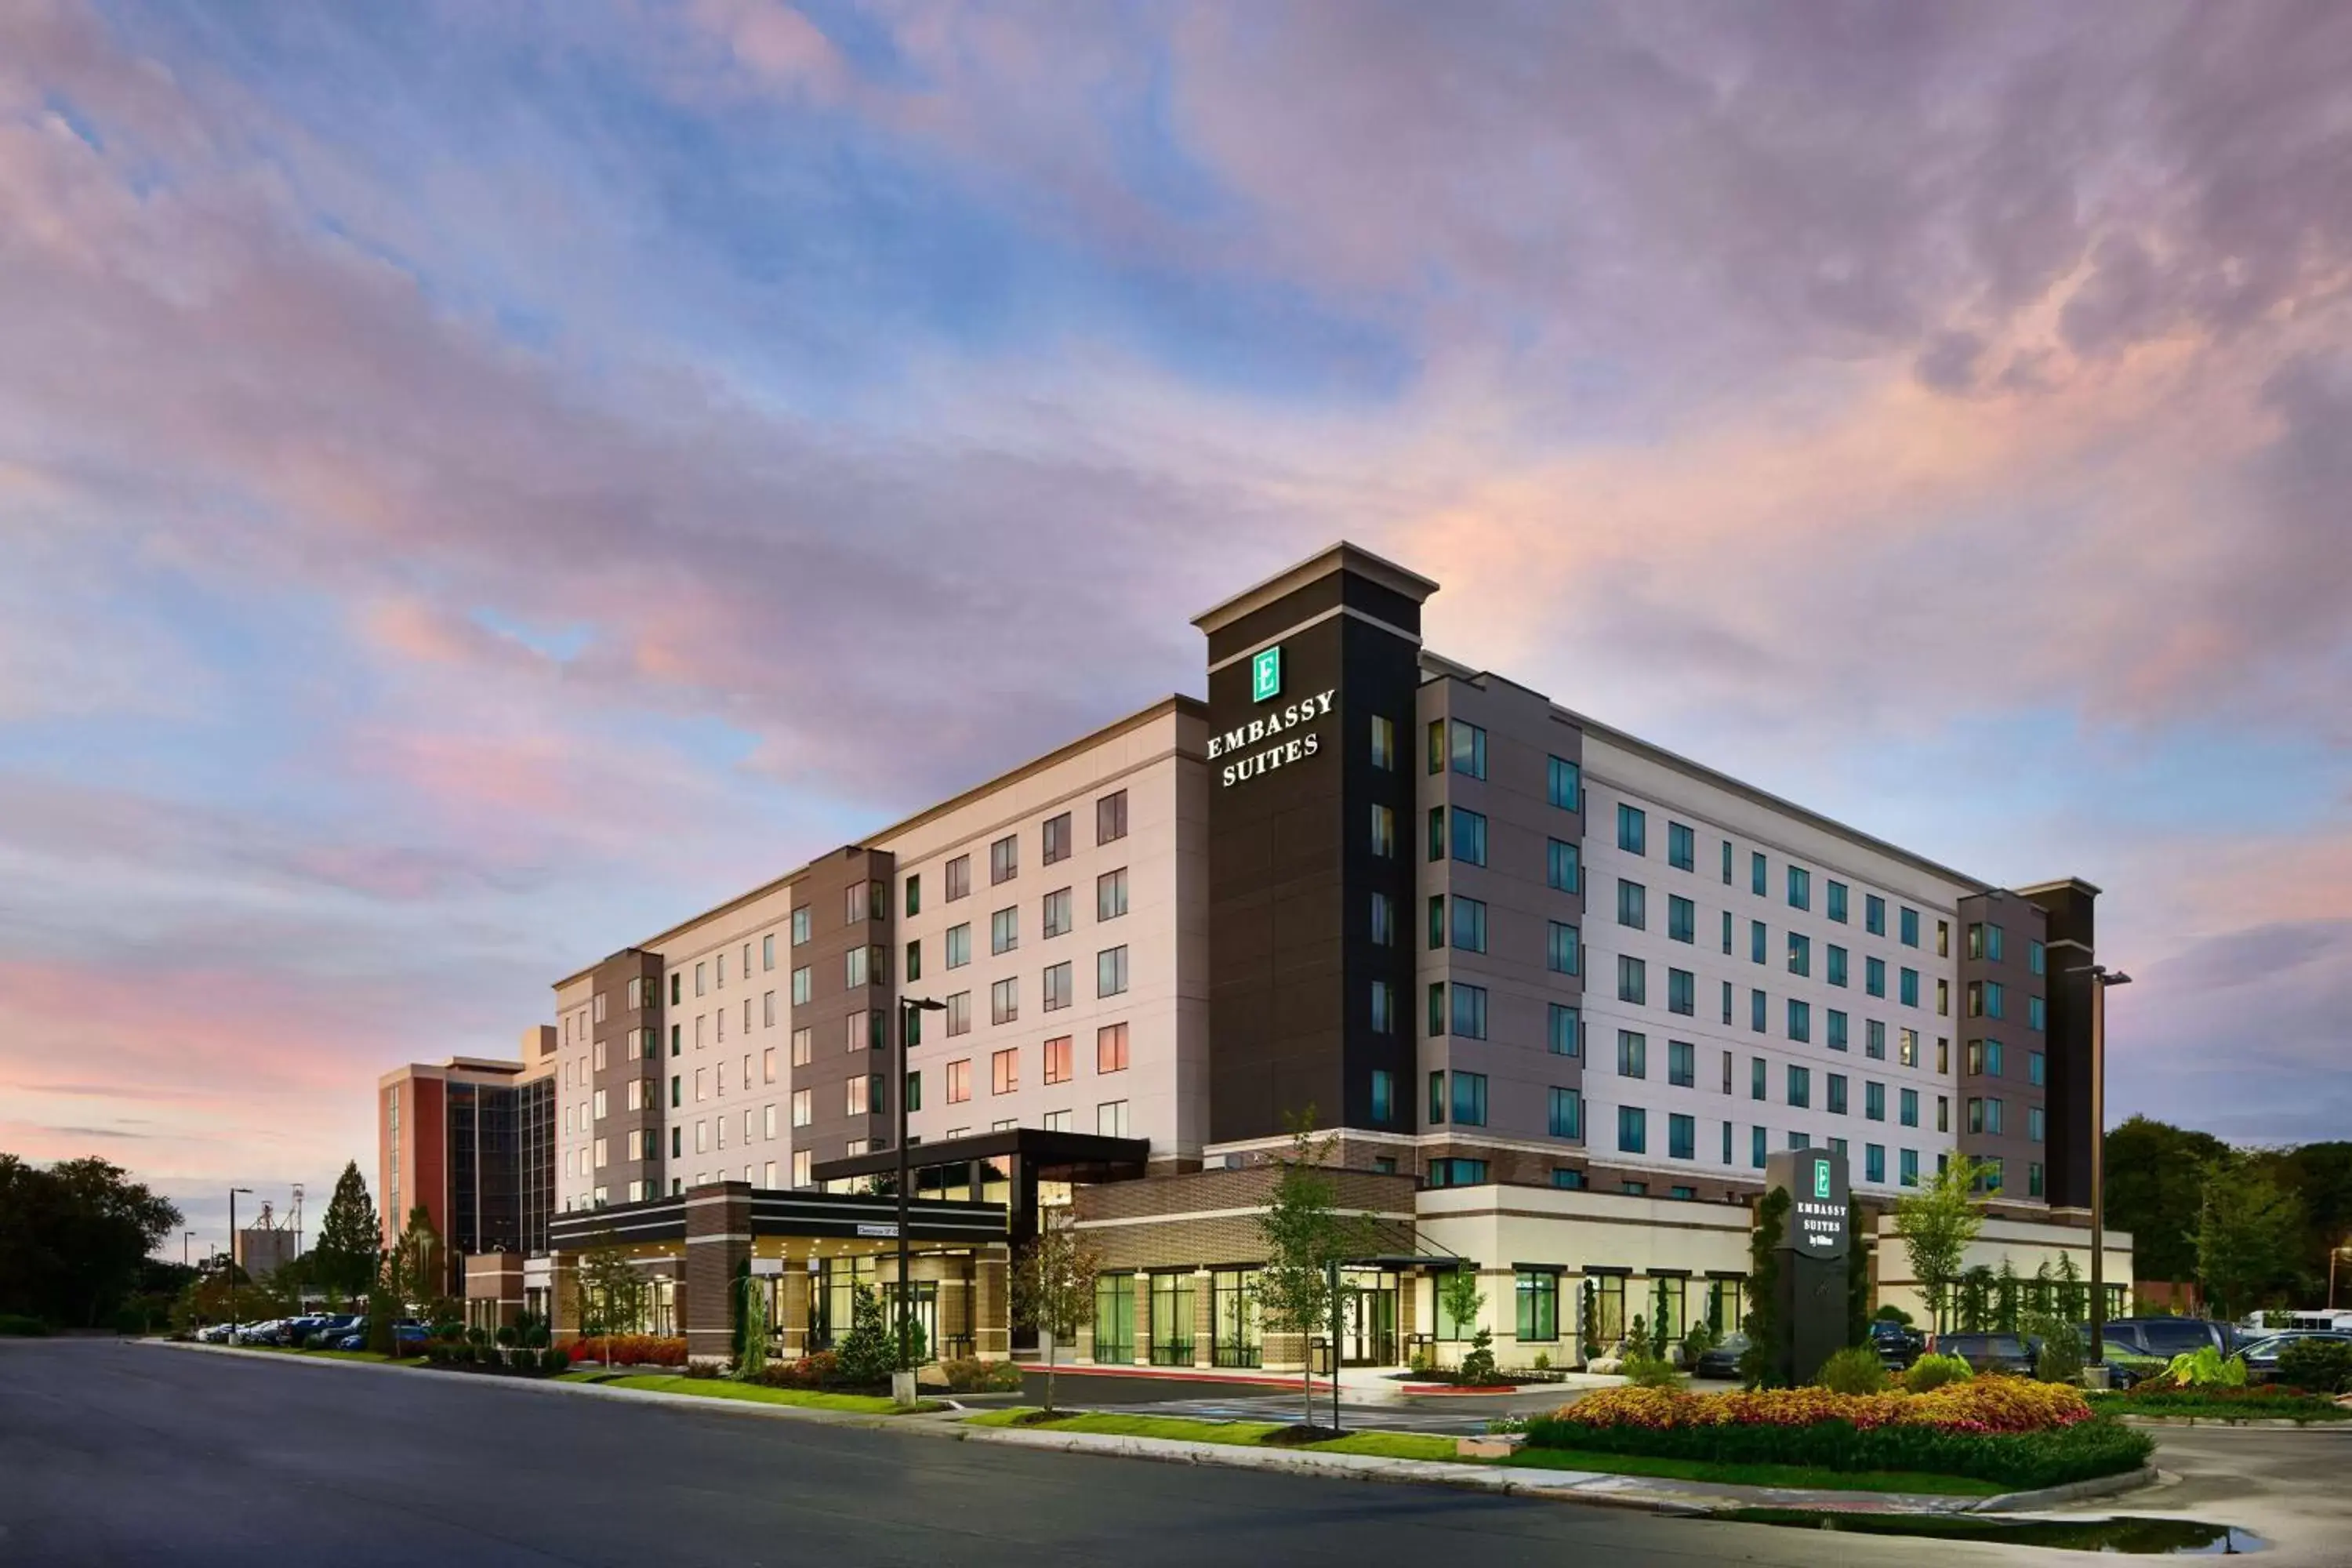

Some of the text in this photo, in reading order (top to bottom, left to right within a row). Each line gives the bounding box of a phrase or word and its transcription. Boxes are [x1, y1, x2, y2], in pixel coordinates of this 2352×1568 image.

[1258, 655, 1274, 693] E
[1207, 689, 1335, 760] EMBASSY
[1222, 733, 1319, 787] SUITES
[1797, 1202, 1846, 1216] EMBASSY
[1804, 1219, 1840, 1232] SUITES
